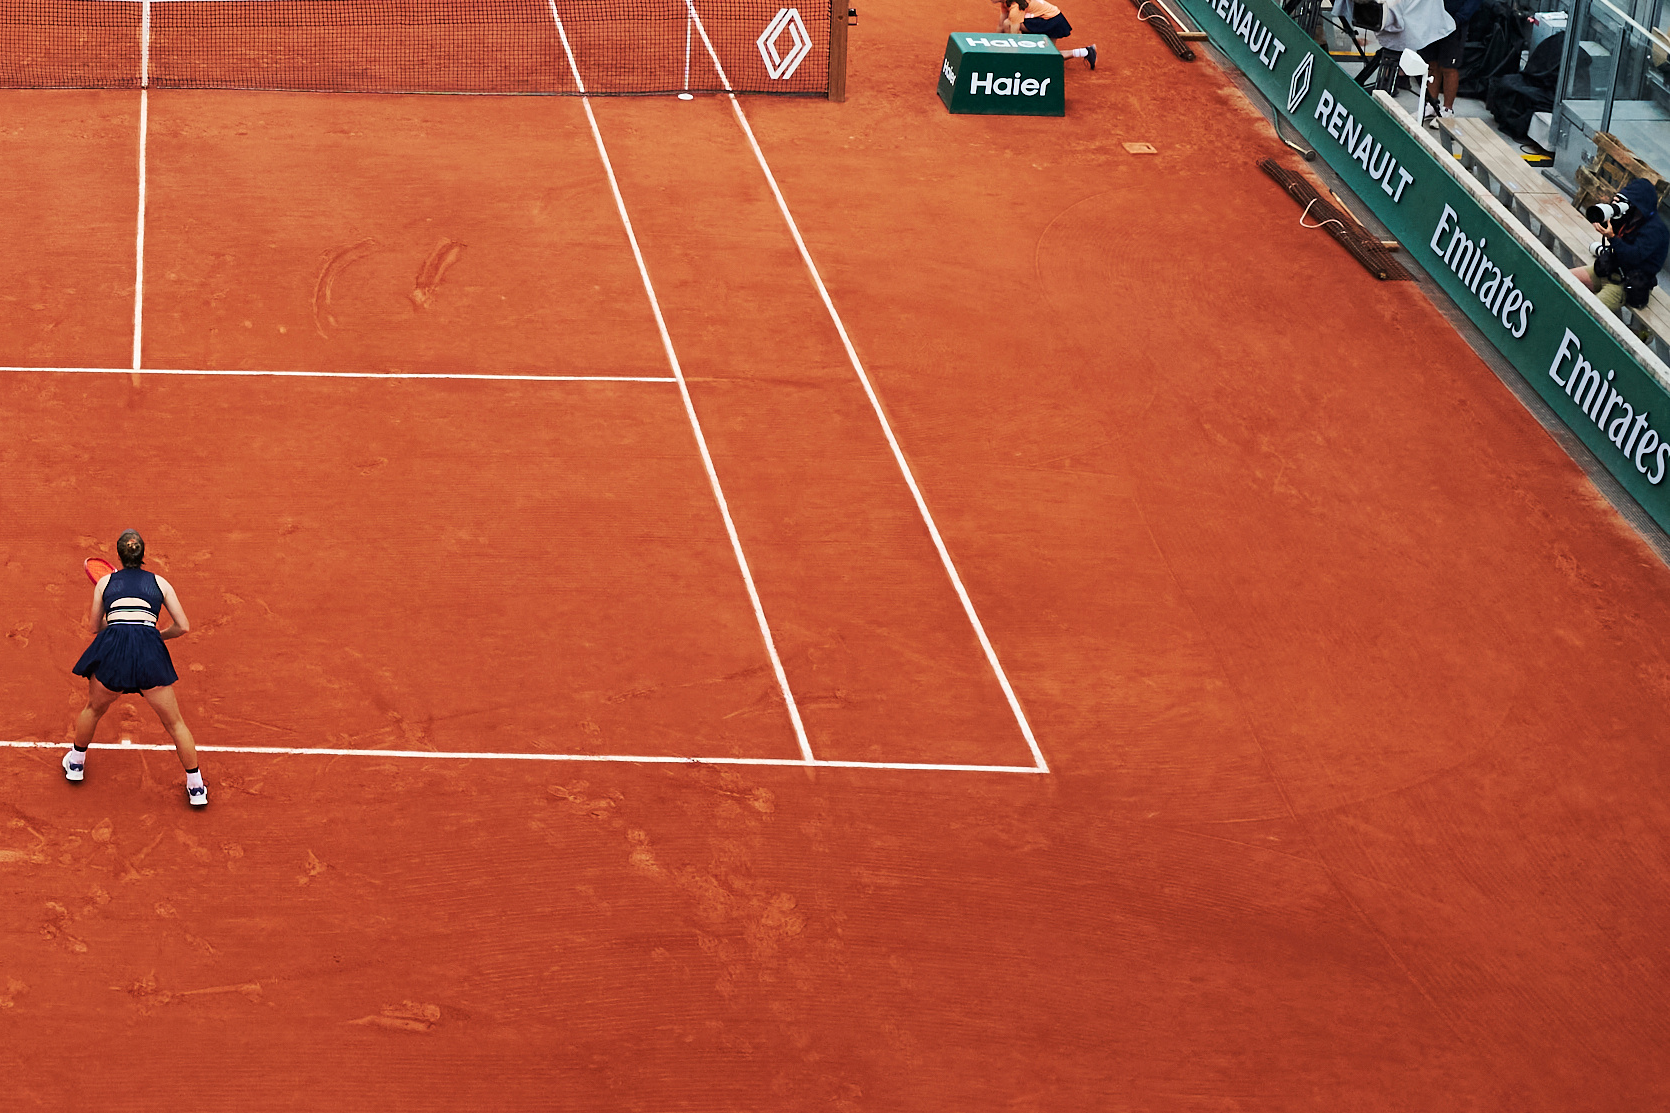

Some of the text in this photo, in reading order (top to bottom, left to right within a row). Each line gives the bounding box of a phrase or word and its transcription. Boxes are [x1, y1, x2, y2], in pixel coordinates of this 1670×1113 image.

[942, 58, 957, 87] Haier
[965, 37, 1048, 48] Haier
[970, 72, 1051, 97] Haier
[1314, 88, 1414, 204] RENAULT
[1430, 202, 1534, 340] Emirates
[1548, 327, 1670, 485] Emirates
